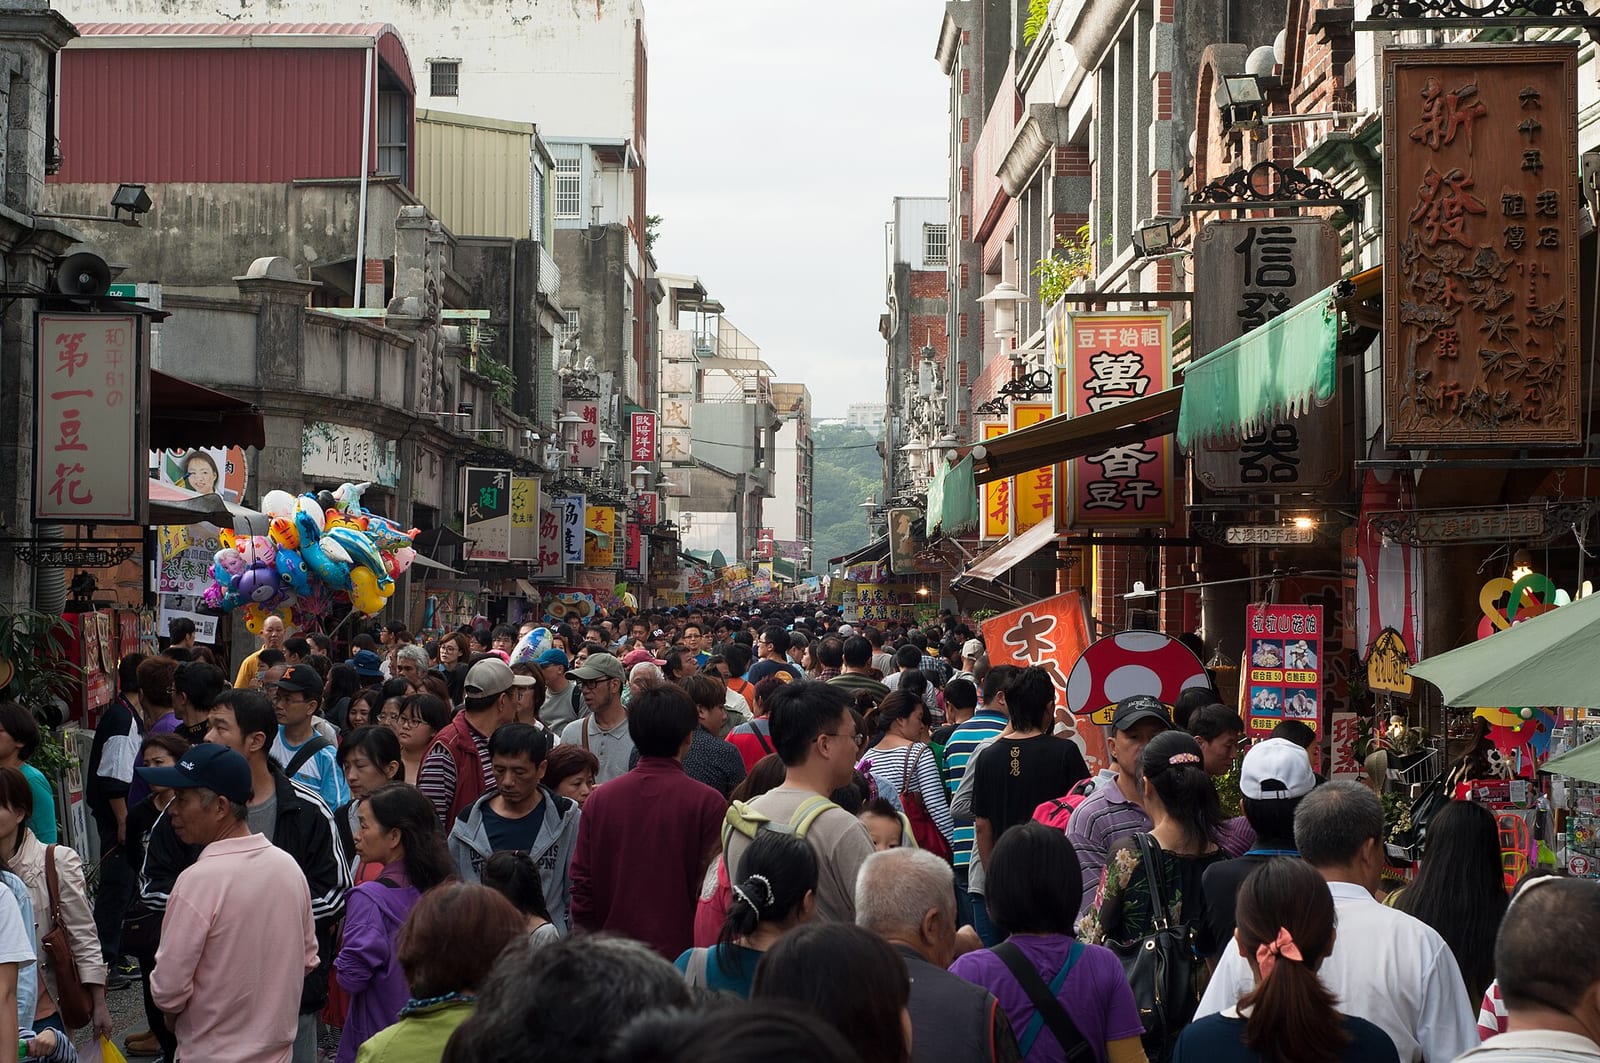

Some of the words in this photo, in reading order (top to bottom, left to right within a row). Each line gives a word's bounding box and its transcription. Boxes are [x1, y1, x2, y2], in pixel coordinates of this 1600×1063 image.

[1518, 86, 1544, 176] 六十年
[1409, 77, 1486, 249] 新發
[104, 327, 125, 408] 和平61の
[1077, 327, 1160, 349] 豆干始祖
[1234, 226, 1300, 483] 信發器
[1434, 277, 1465, 411] 木器行
[48, 332, 94, 506] 第一豆花
[581, 405, 597, 448] 朝陽
[635, 415, 651, 460] 歐陽洋傘
[1085, 482, 1161, 511] 豆干
[1274, 671, 1282, 681] 50
[1308, 673, 1316, 682] 50
